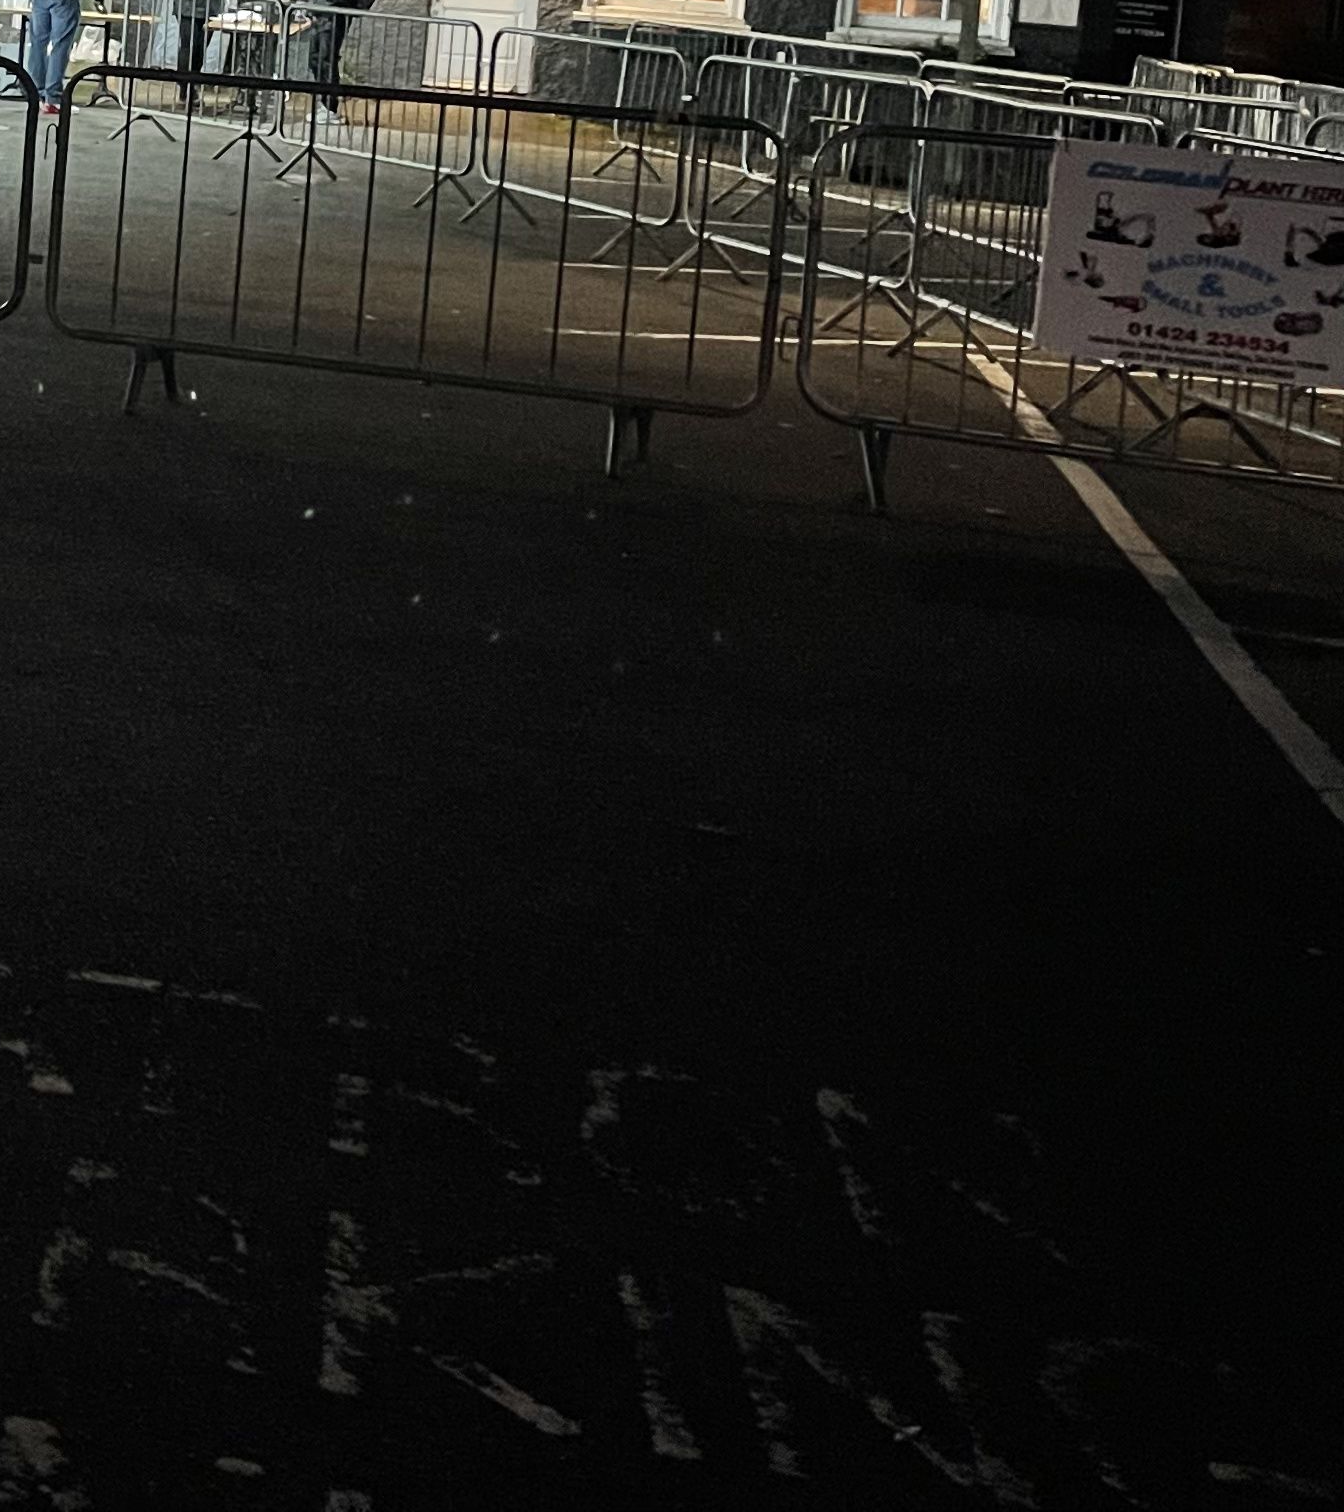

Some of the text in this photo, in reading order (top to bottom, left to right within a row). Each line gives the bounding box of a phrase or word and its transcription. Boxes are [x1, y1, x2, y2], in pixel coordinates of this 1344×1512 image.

[1223, 178, 1302, 198] PLANT
[1302, 185, 1344, 202] HIR
[1148, 253, 1280, 283] MACHINERY
[1142, 280, 1286, 319] SMALL TOOLS
[1198, 272, 1226, 297] &
[1128, 322, 1197, 342] 01424
[1207, 332, 1290, 354] 234534
